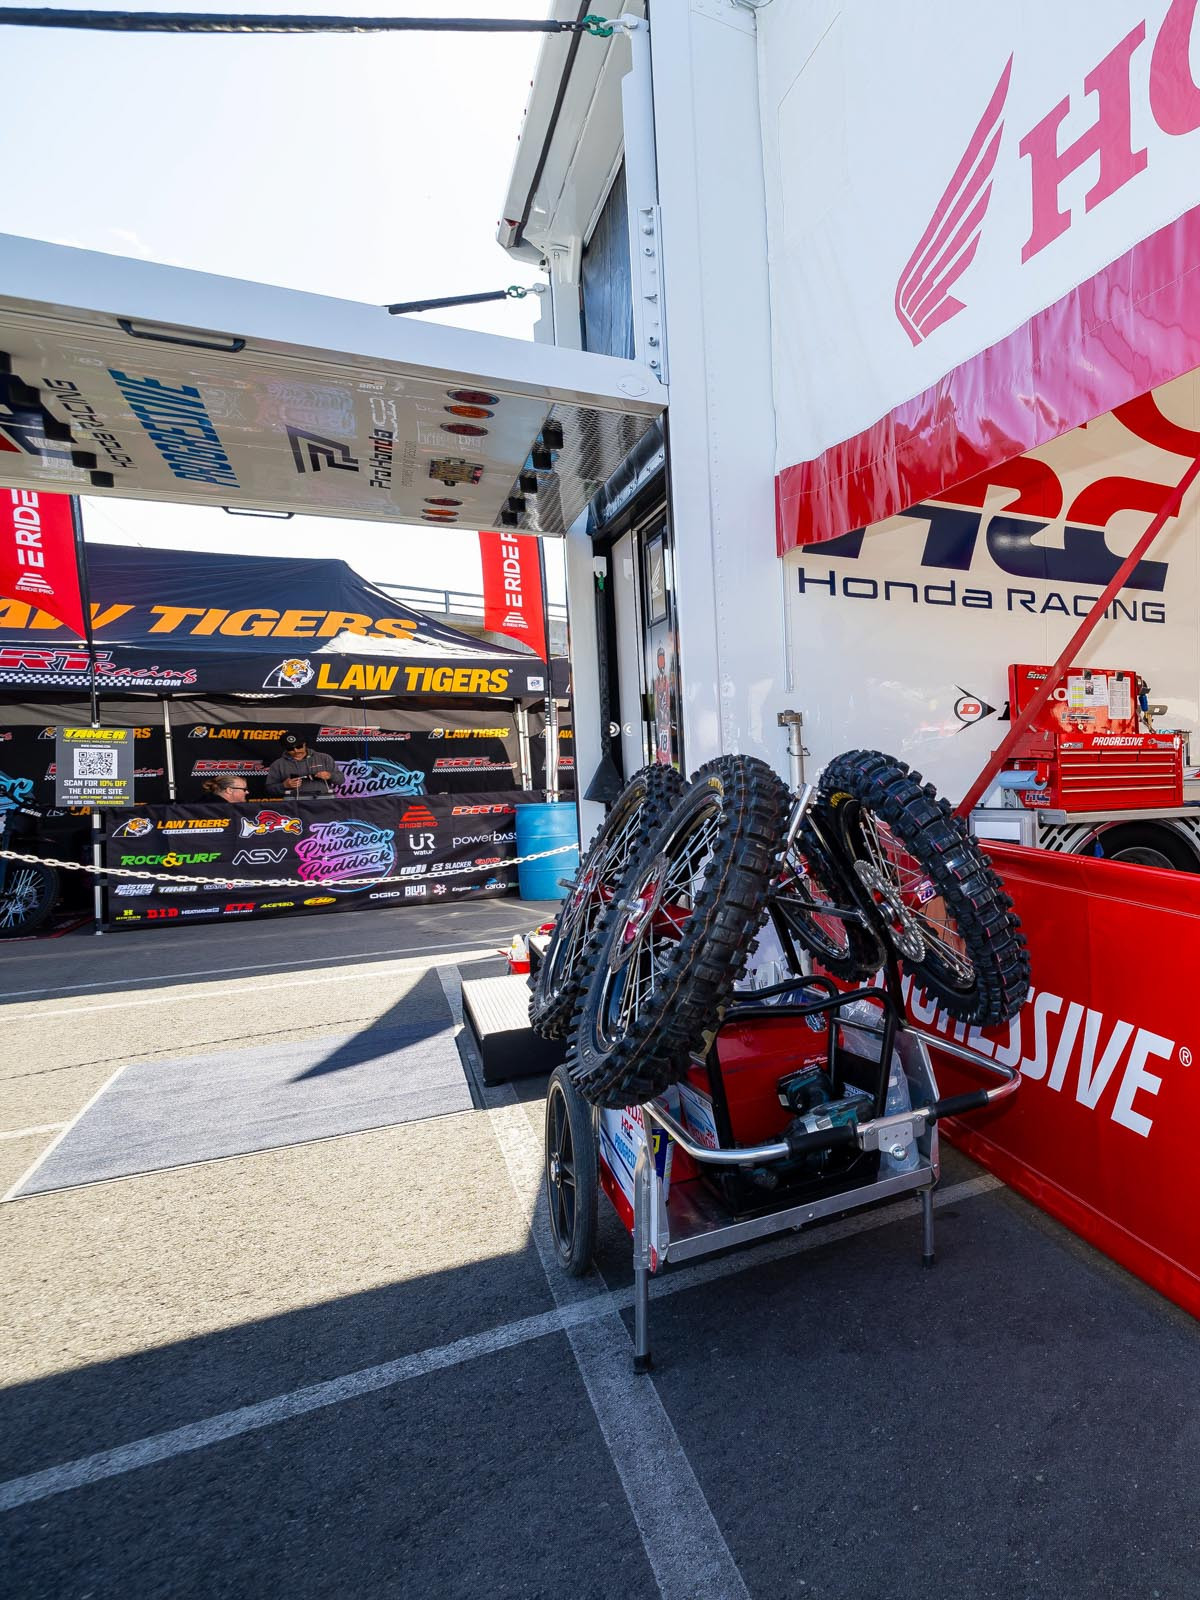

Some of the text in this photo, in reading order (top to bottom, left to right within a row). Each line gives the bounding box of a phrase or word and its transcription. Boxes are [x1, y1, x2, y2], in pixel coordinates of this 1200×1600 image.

[107, 368, 241, 488] PROGRESSIVE
[369, 428, 395, 490] ProHonda
[11, 489, 42, 548] RIDE
[502, 545, 522, 592] RIDE
[797, 567, 994, 610] Honda
[148, 604, 417, 641] TIGERS
[95, 661, 197, 684] Racing
[316, 663, 399, 691] LAW
[404, 666, 508, 693] TIGERS
[130, 678, 182, 687] INC.COM
[63, 728, 128, 740] TAMER
[208, 728, 241, 739] LAW
[444, 727, 510, 739] LAW TIGERS
[558, 729, 574, 739] AW
[1091, 736, 1145, 747] PROGRESSIVE
[156, 818, 232, 829] LAW TIGERS
[317, 822, 347, 836] The
[299, 829, 395, 858] Privateer
[302, 849, 391, 880] Paddock
[445, 860, 472, 869] SLACKER
[485, 881, 506, 890] cardo
[370, 891, 400, 899] OGIO
